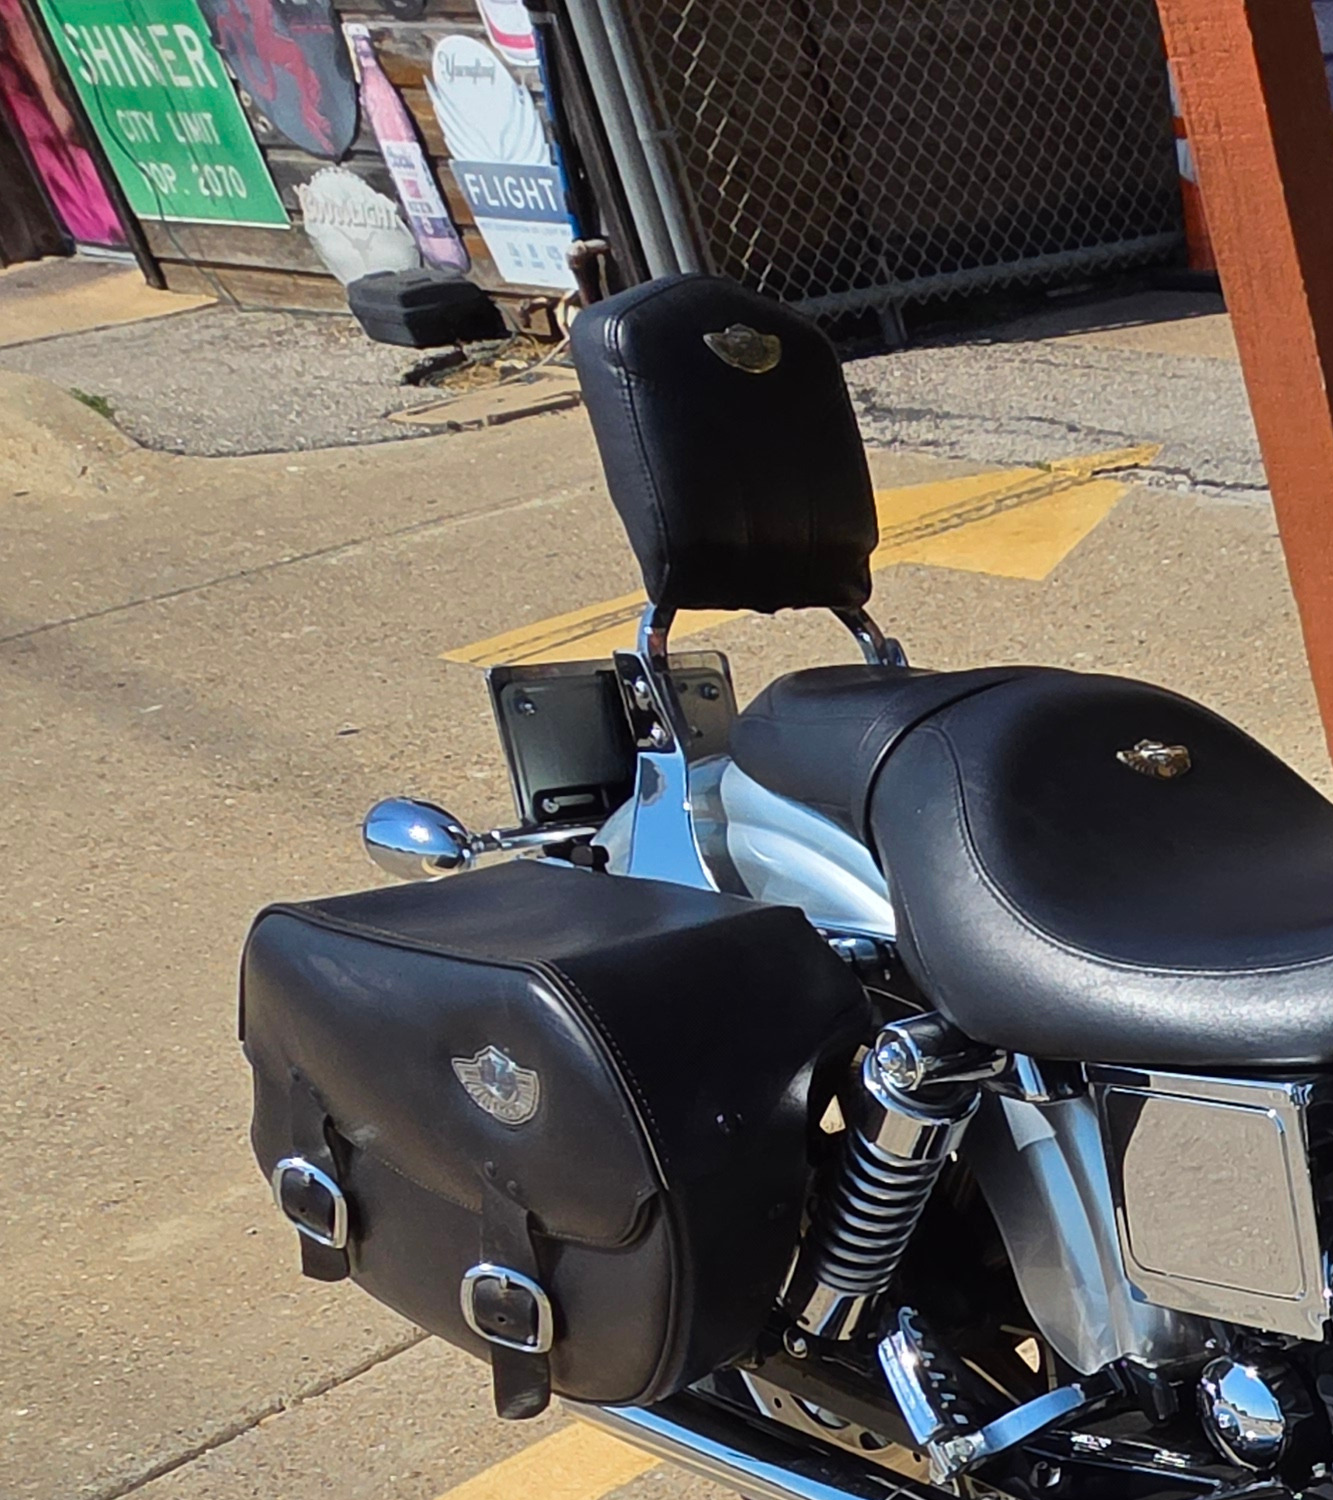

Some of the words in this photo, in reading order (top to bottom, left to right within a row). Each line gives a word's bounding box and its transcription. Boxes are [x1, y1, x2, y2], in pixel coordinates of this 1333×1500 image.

[65, 23, 218, 88] SHINER
[116, 110, 160, 143] CITY
[166, 111, 220, 145] LIMIT
[192, 163, 247, 198] 2070
[464, 173, 558, 211] FLIGHT
